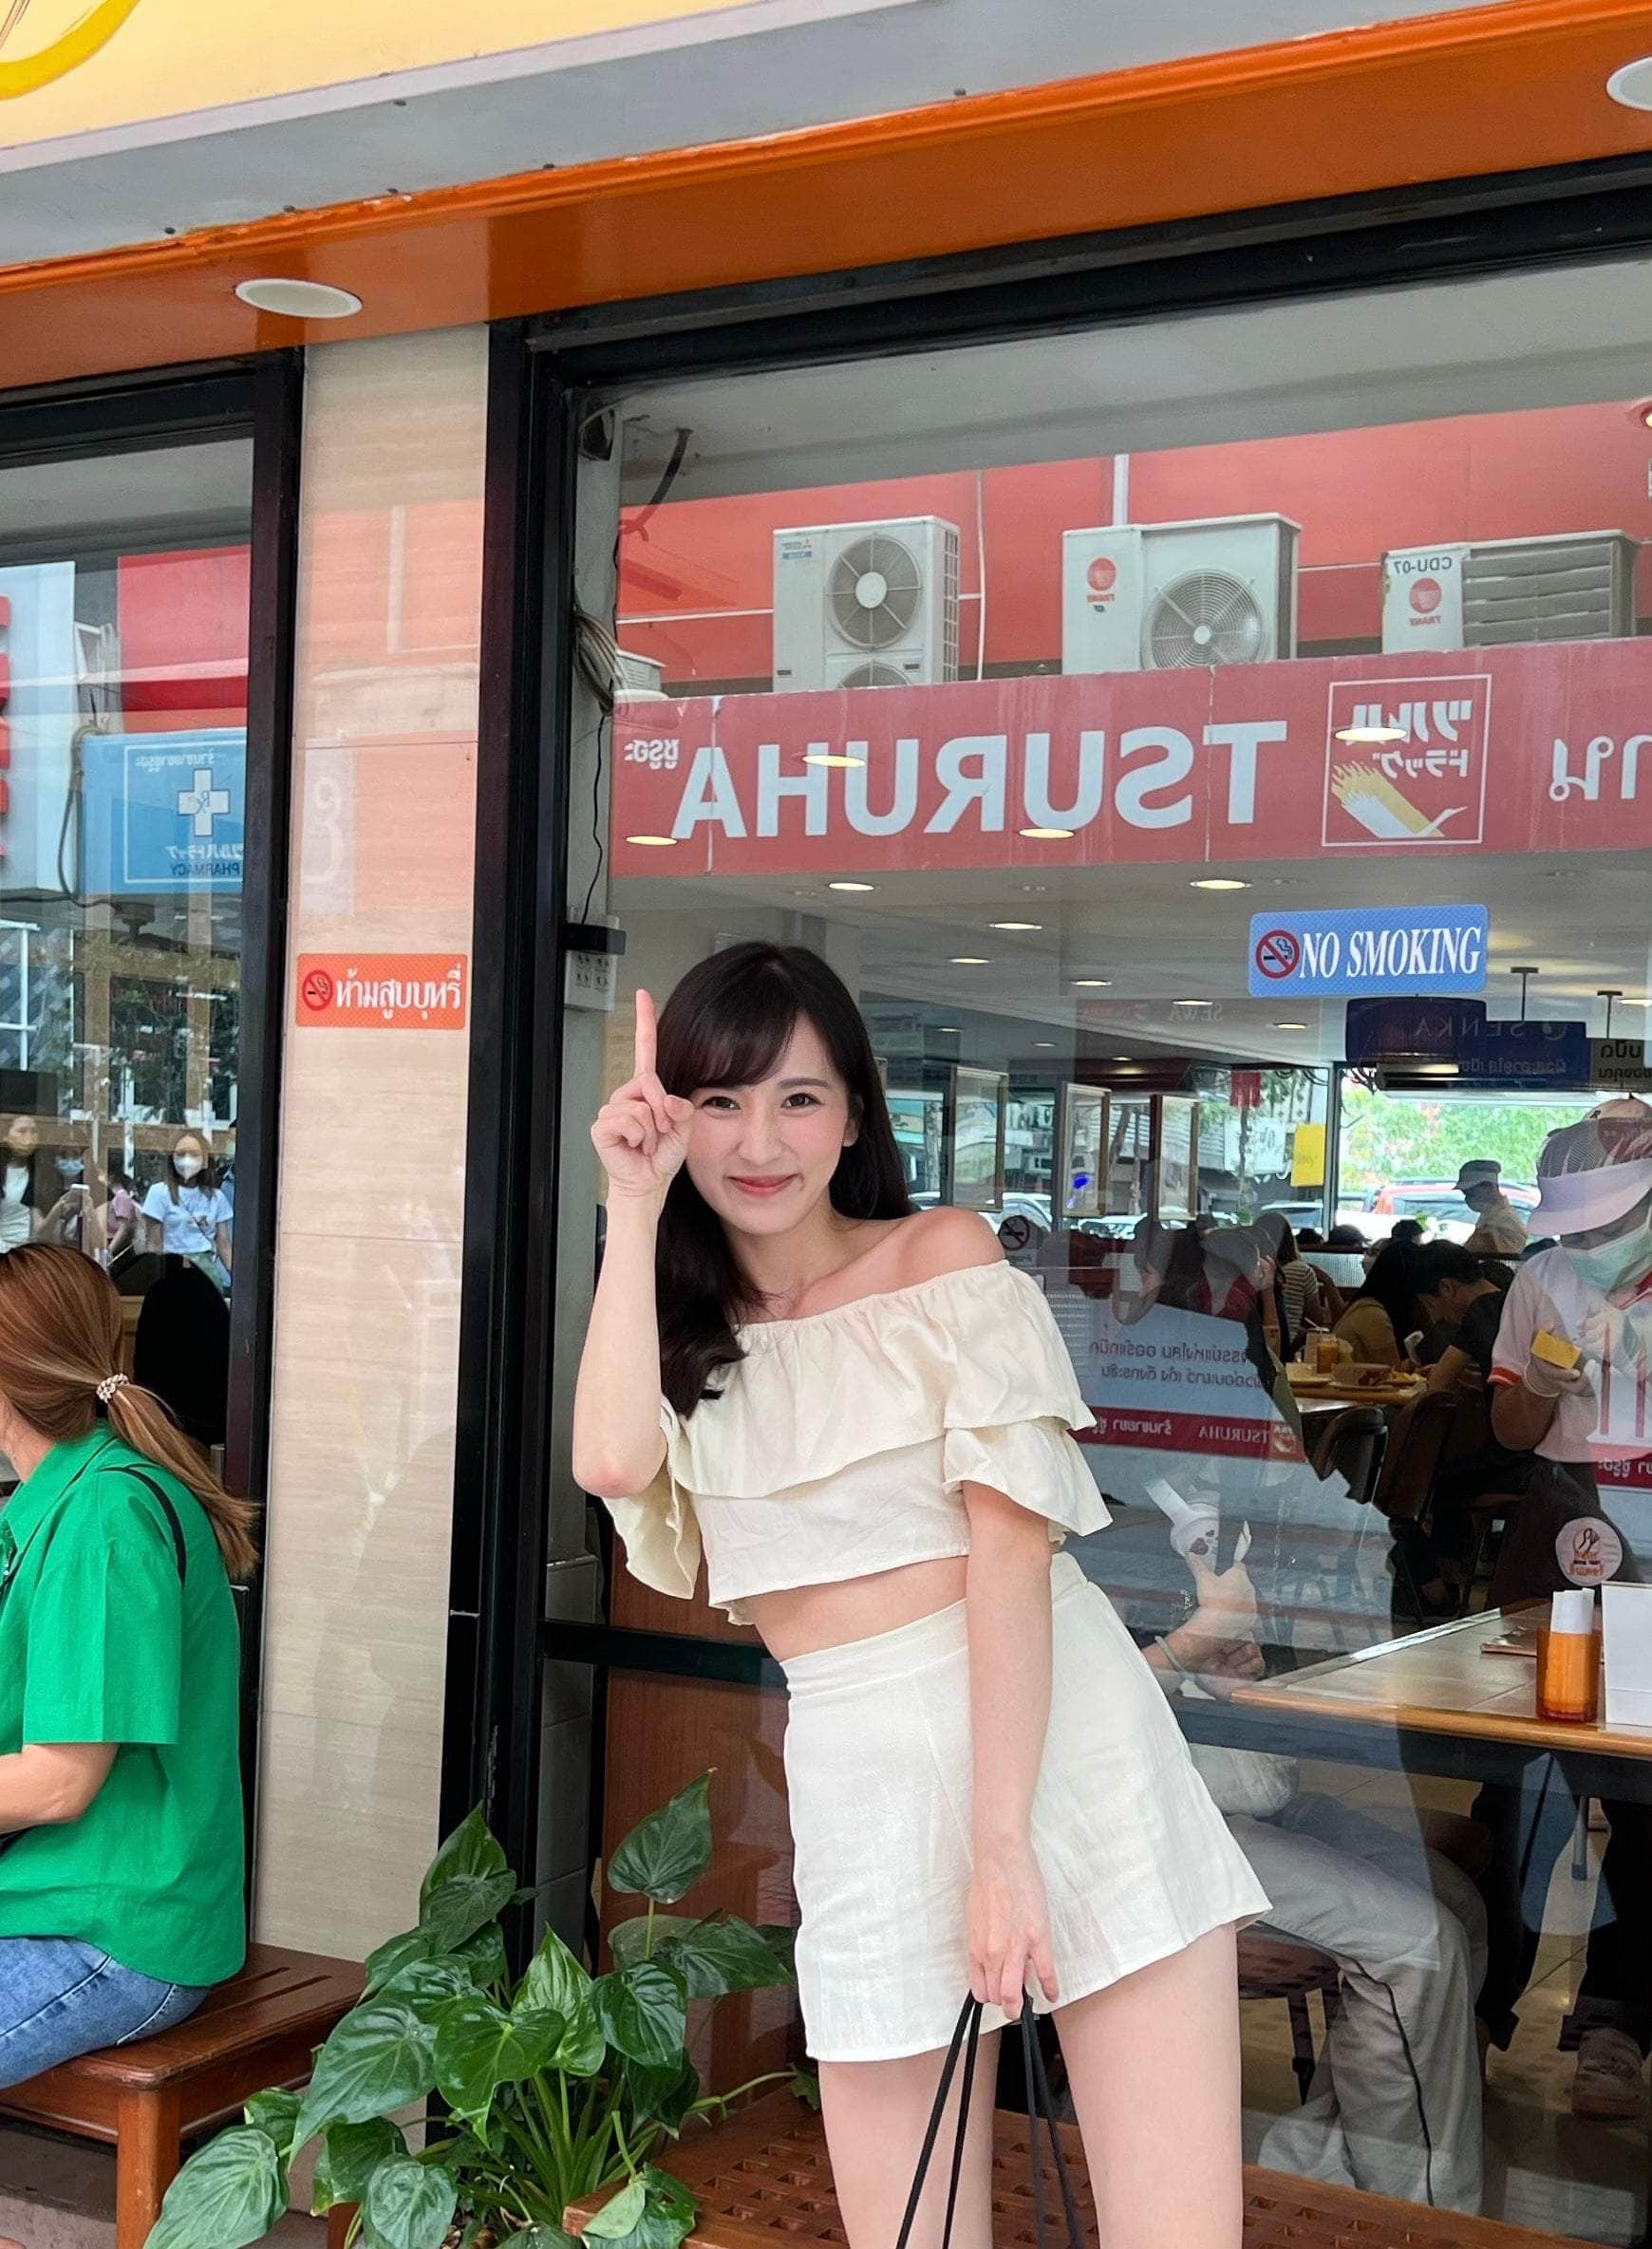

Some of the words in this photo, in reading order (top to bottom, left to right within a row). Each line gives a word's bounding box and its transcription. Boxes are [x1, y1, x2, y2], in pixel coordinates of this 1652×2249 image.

[1299, 932, 1341, 979] NO
[1346, 927, 1482, 978] SMOKING
[335, 963, 462, 1021] ห้ามสูบบุหรี่
